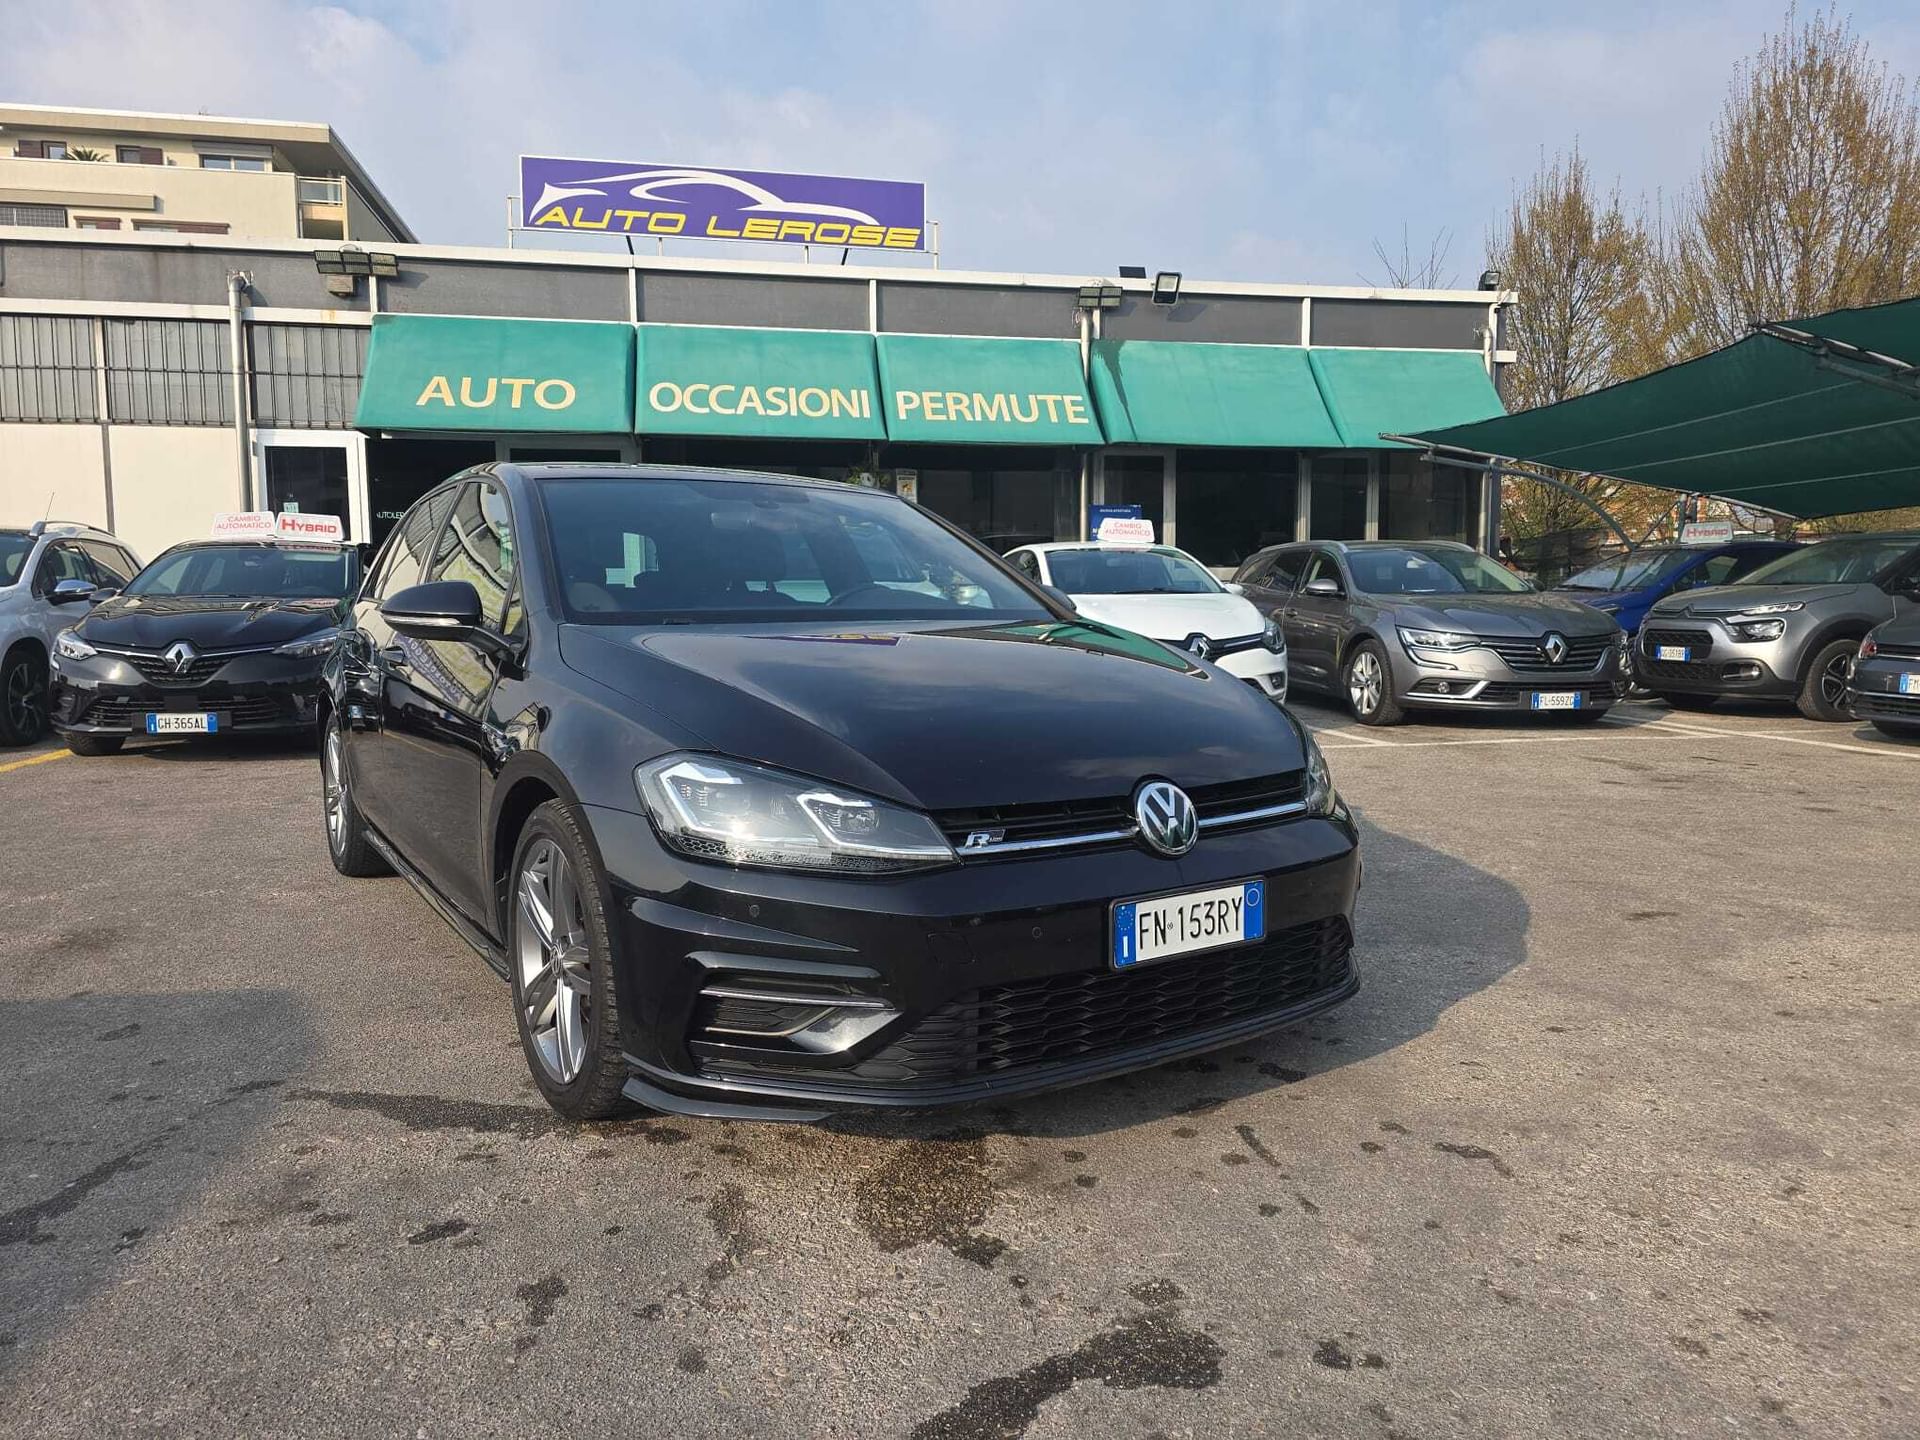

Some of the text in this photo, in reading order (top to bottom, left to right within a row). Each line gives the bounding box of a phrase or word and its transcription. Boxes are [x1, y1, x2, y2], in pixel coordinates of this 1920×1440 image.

[535, 206, 921, 248] AUTO LEROSE
[415, 375, 577, 410] AUTO
[648, 381, 871, 418] OCCASIONI
[895, 390, 1090, 425] PERMUTE
[215, 521, 272, 530] AUTOMATICO
[227, 515, 262, 523] CAMBIO
[281, 518, 337, 534] HYBRID
[1105, 528, 1151, 537] AUTOMATICO
[1139, 909, 1167, 950] FN
[1177, 896, 1243, 942] 153RY
